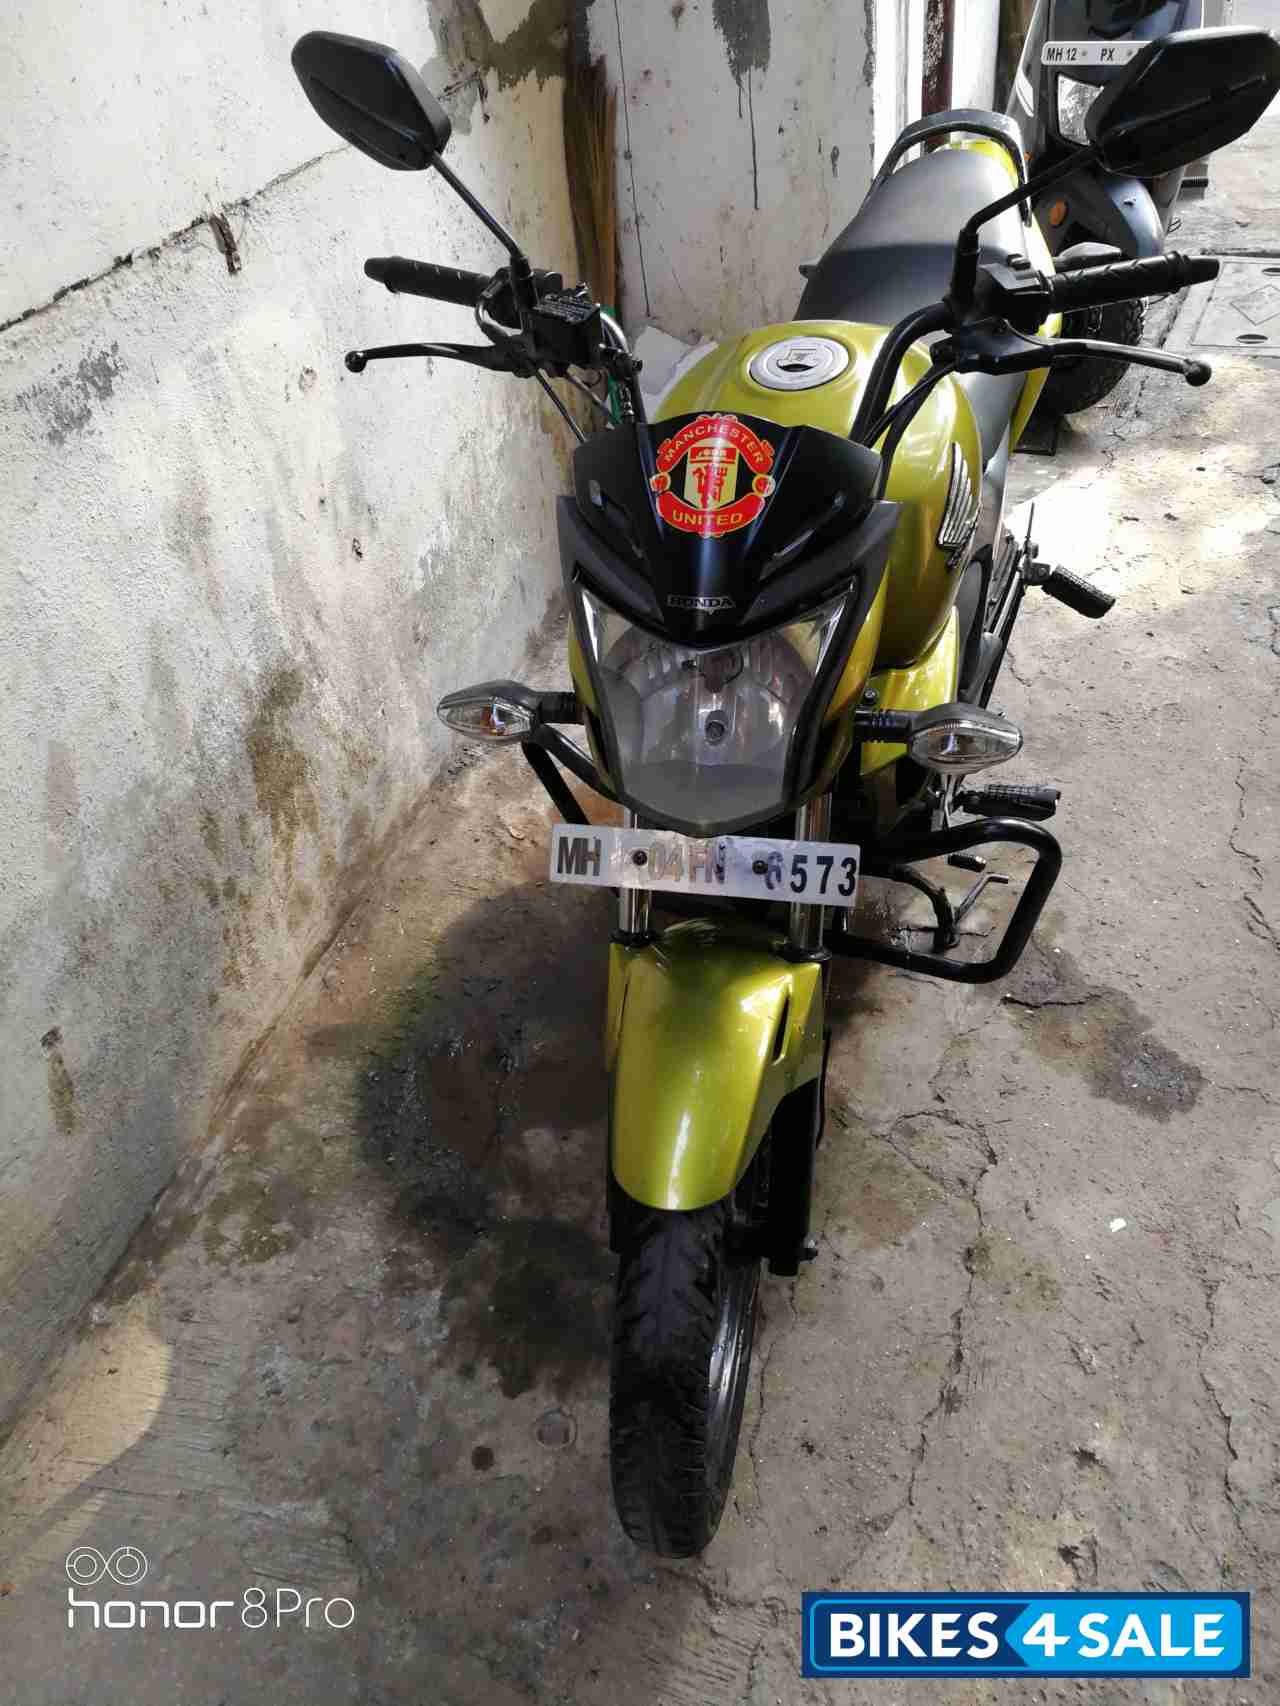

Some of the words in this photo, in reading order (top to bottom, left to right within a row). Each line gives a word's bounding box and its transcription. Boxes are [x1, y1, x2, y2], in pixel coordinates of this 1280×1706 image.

[1046, 47, 1063, 61] MH
[1066, 47, 1078, 61] 12
[1100, 47, 1115, 61] PX
[664, 422, 765, 464] MANCHESTER
[672, 509, 744, 526] UNITED
[666, 594, 737, 609] HONDA
[556, 835, 602, 877] MH
